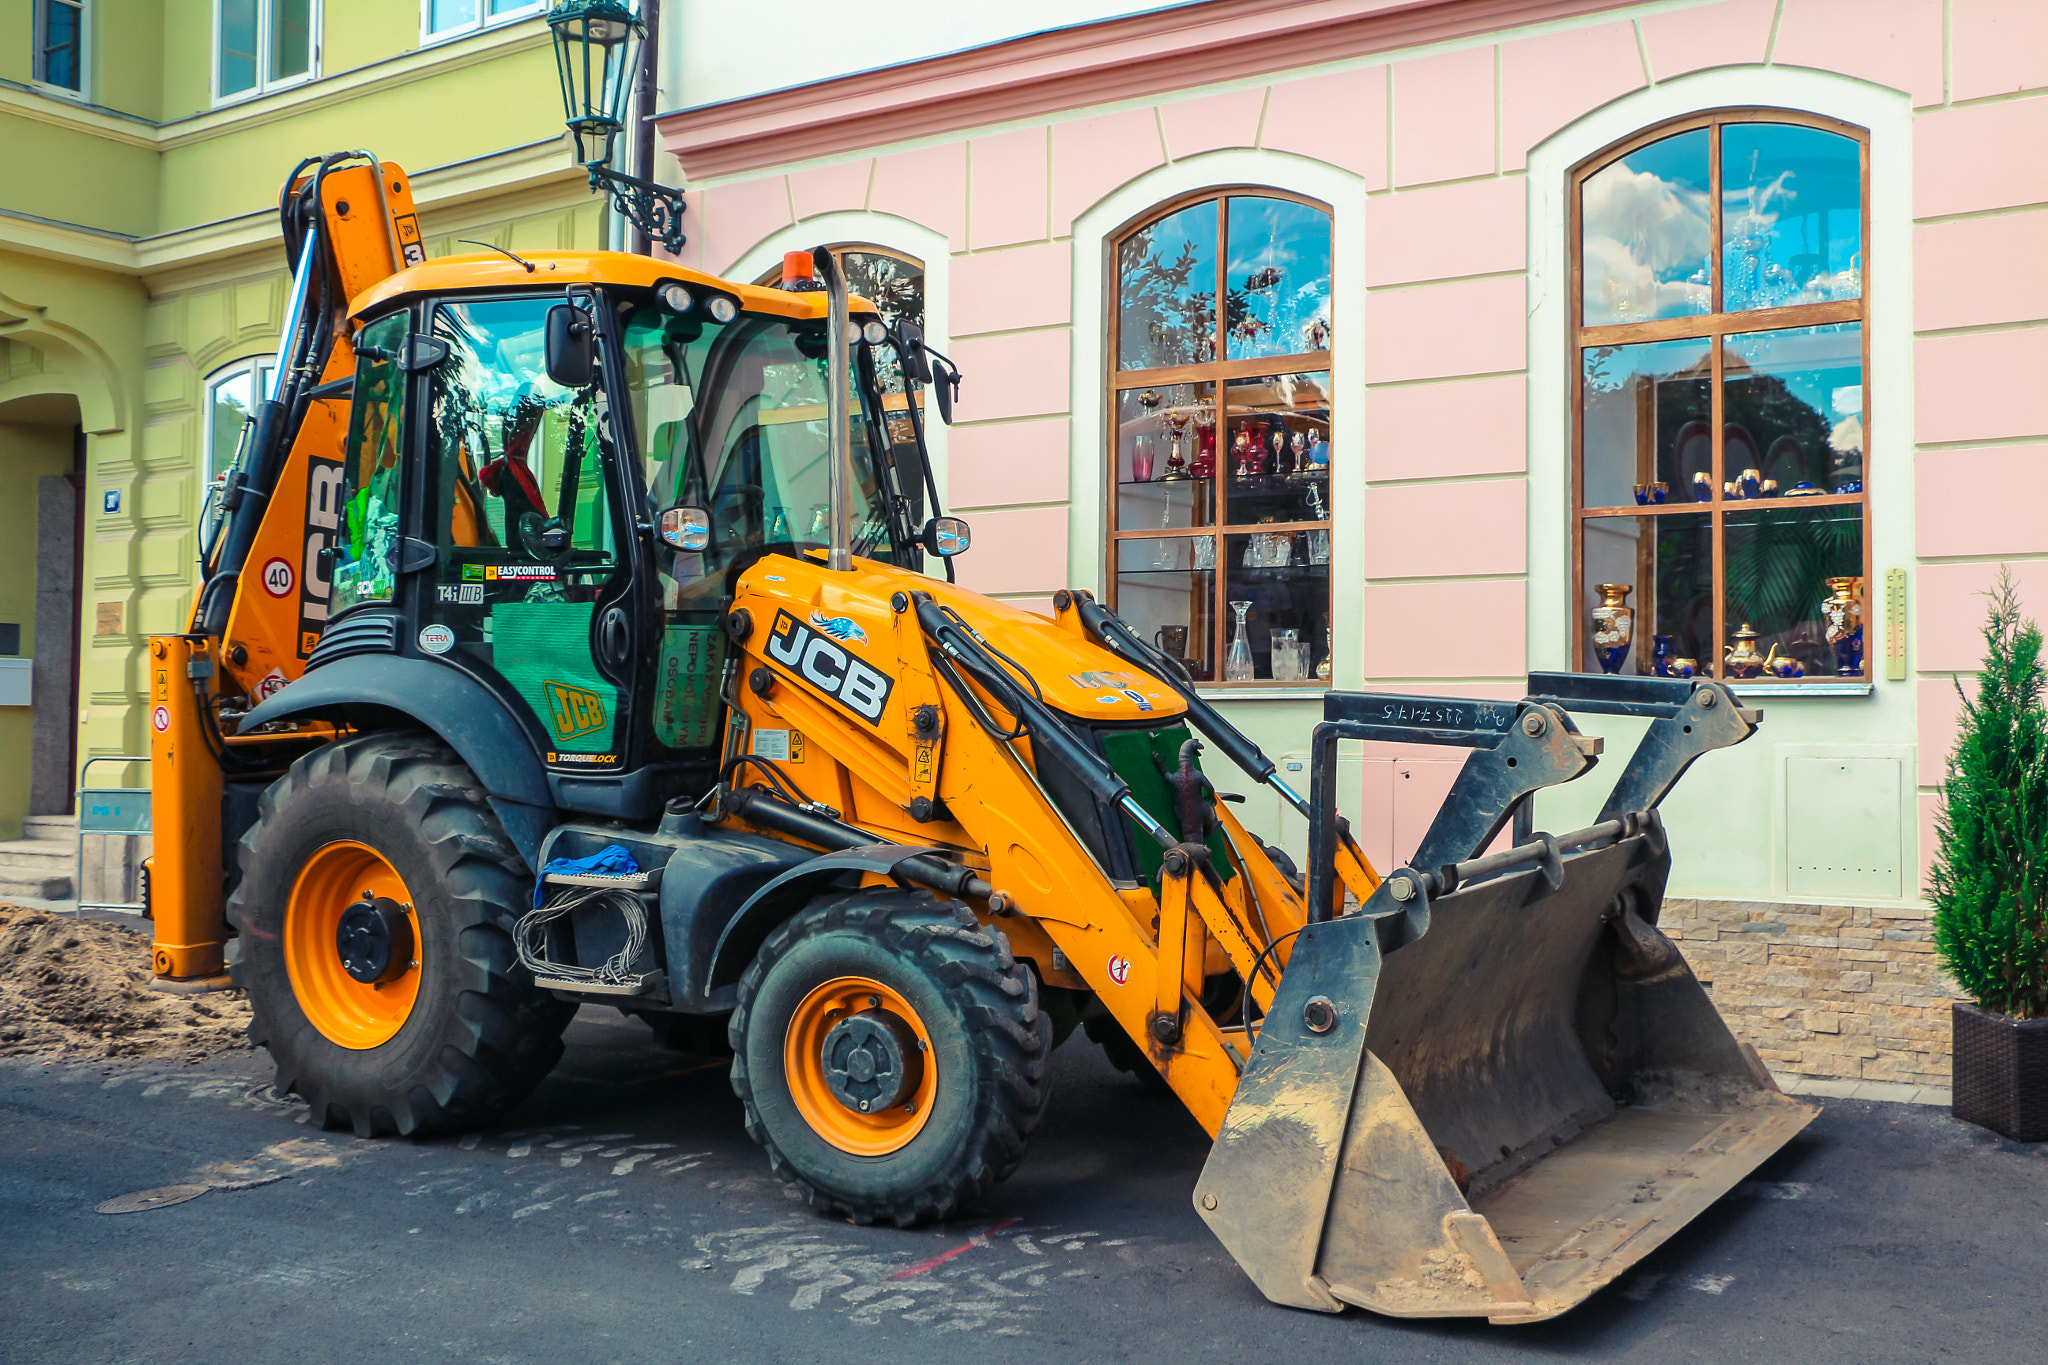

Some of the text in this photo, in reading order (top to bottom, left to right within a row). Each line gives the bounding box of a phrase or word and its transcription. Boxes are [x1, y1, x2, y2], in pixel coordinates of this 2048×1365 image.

[268, 568, 289, 588] 40
[497, 566, 556, 578] EASYCONTROL
[437, 585, 458, 602] T4i
[425, 634, 449, 642] TERRA
[769, 626, 887, 718] JCB
[554, 687, 603, 735] JCB
[558, 753, 618, 763] TORQUELOCK
